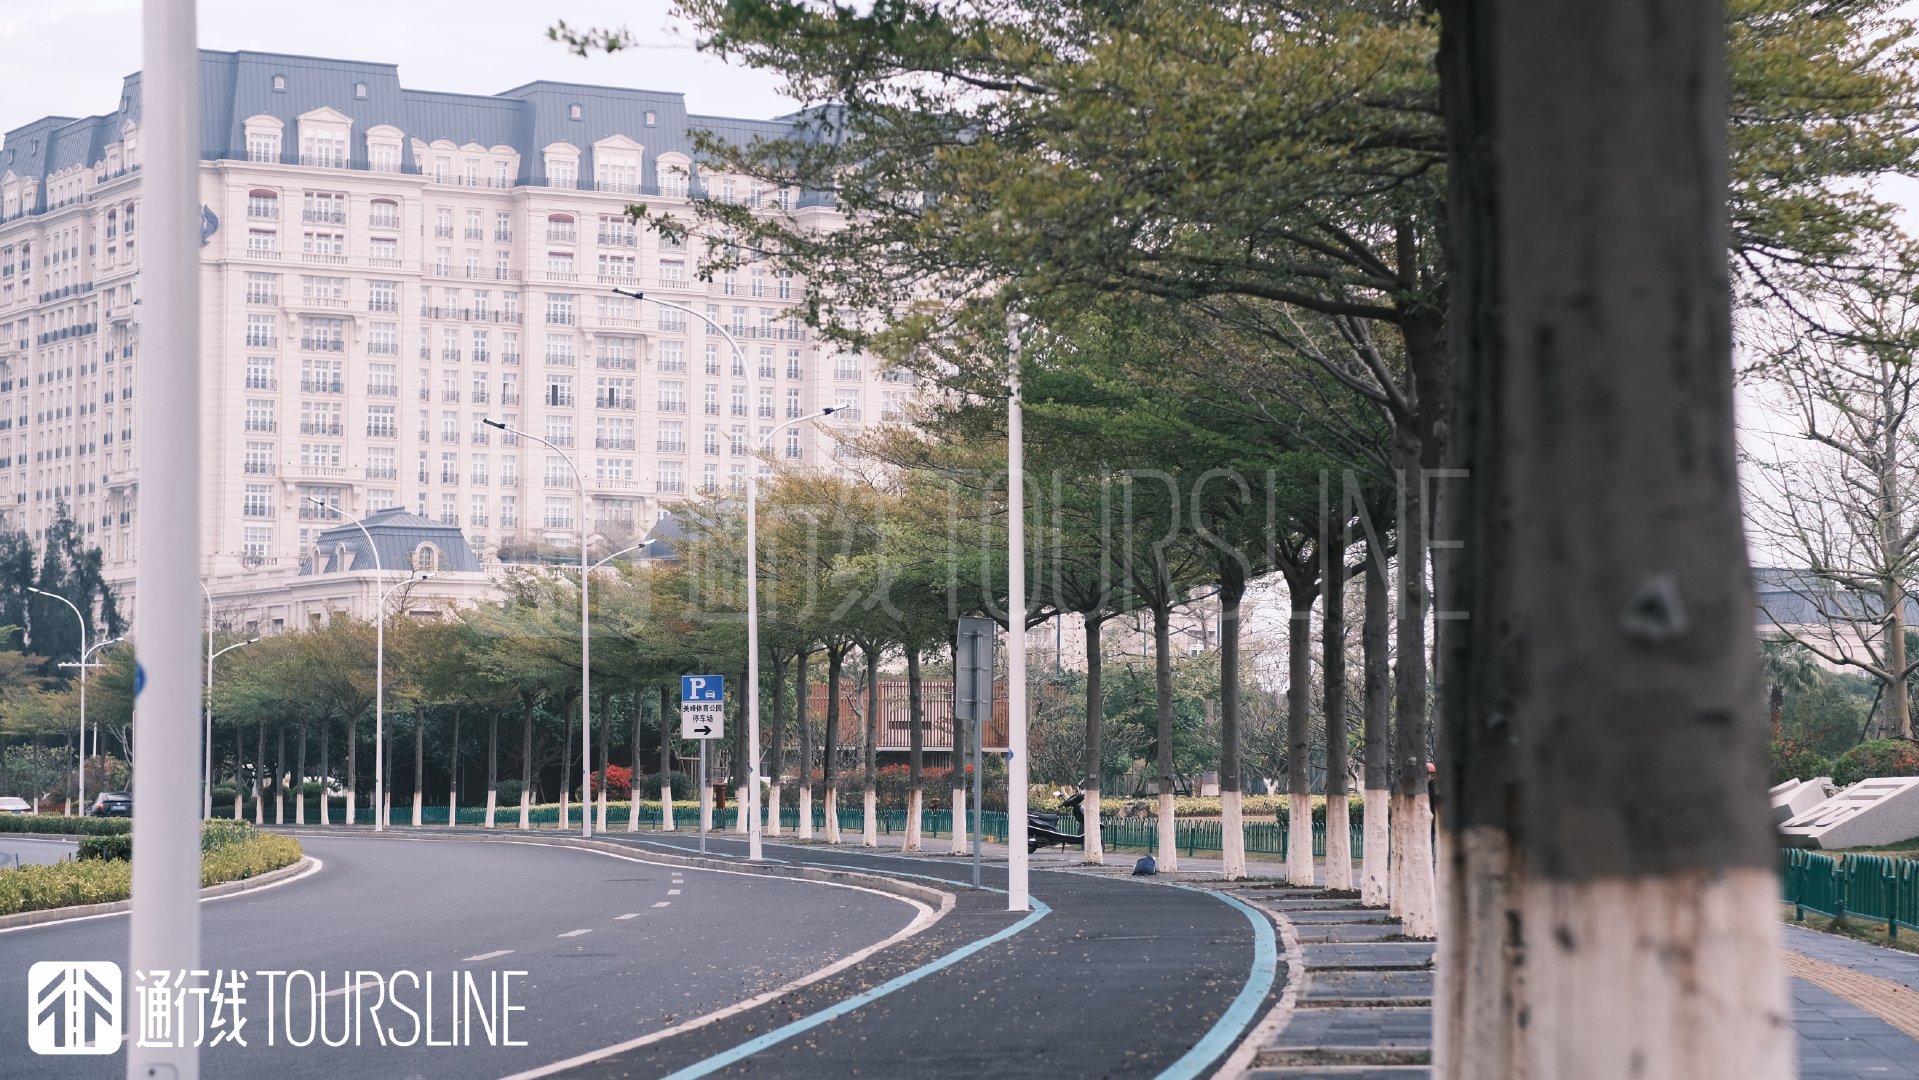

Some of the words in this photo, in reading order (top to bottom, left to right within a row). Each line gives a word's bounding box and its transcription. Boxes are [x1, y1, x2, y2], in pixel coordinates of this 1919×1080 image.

[689, 677, 706, 700] P
[692, 714, 714, 723] 停车场
